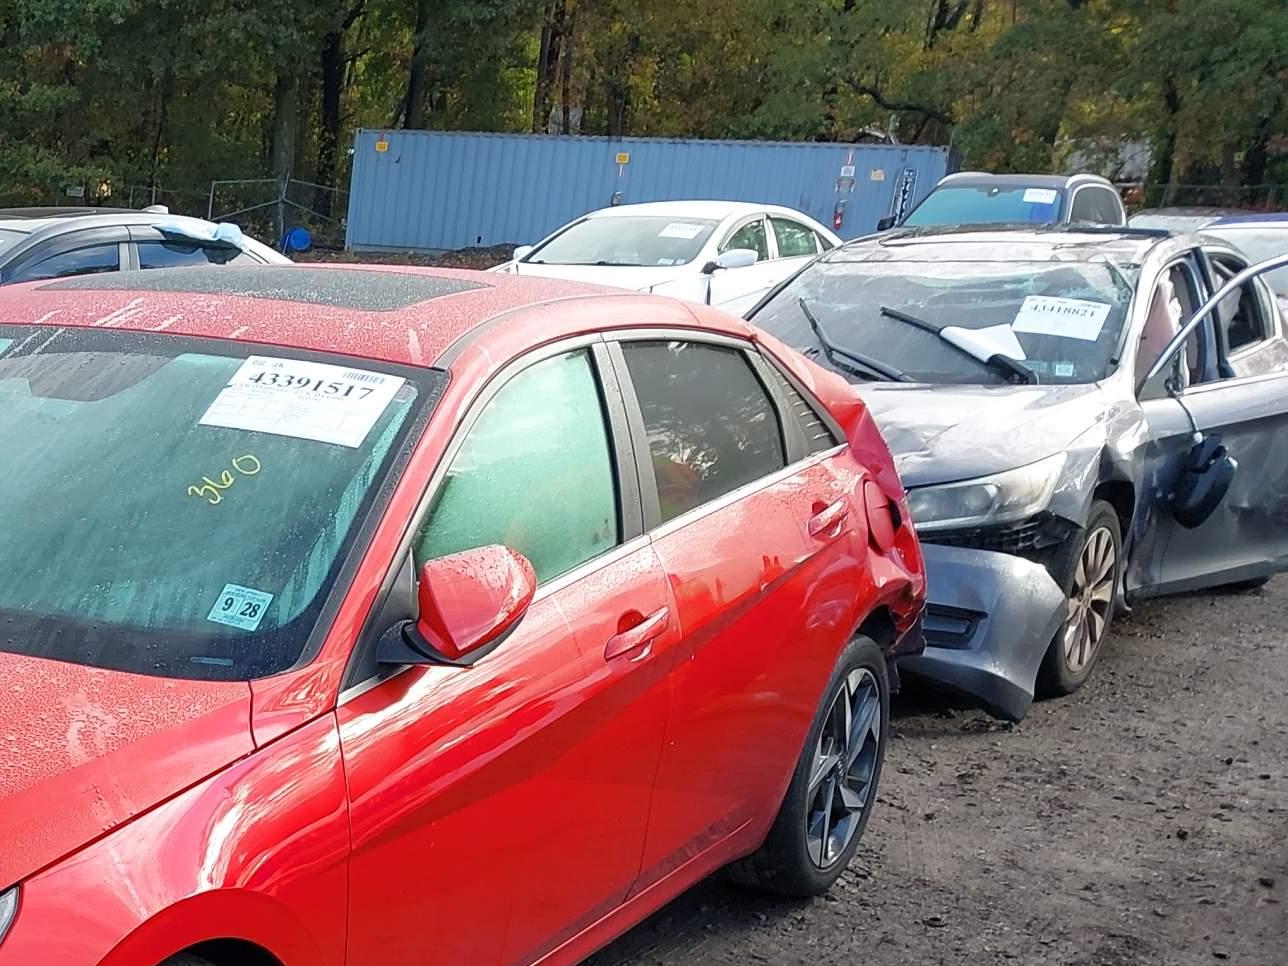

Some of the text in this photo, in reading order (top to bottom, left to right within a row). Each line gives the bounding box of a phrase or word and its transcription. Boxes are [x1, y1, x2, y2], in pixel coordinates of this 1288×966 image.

[248, 371, 375, 400] 43391517
[187, 454, 261, 505] 360
[222, 597, 261, 618] 9 28
